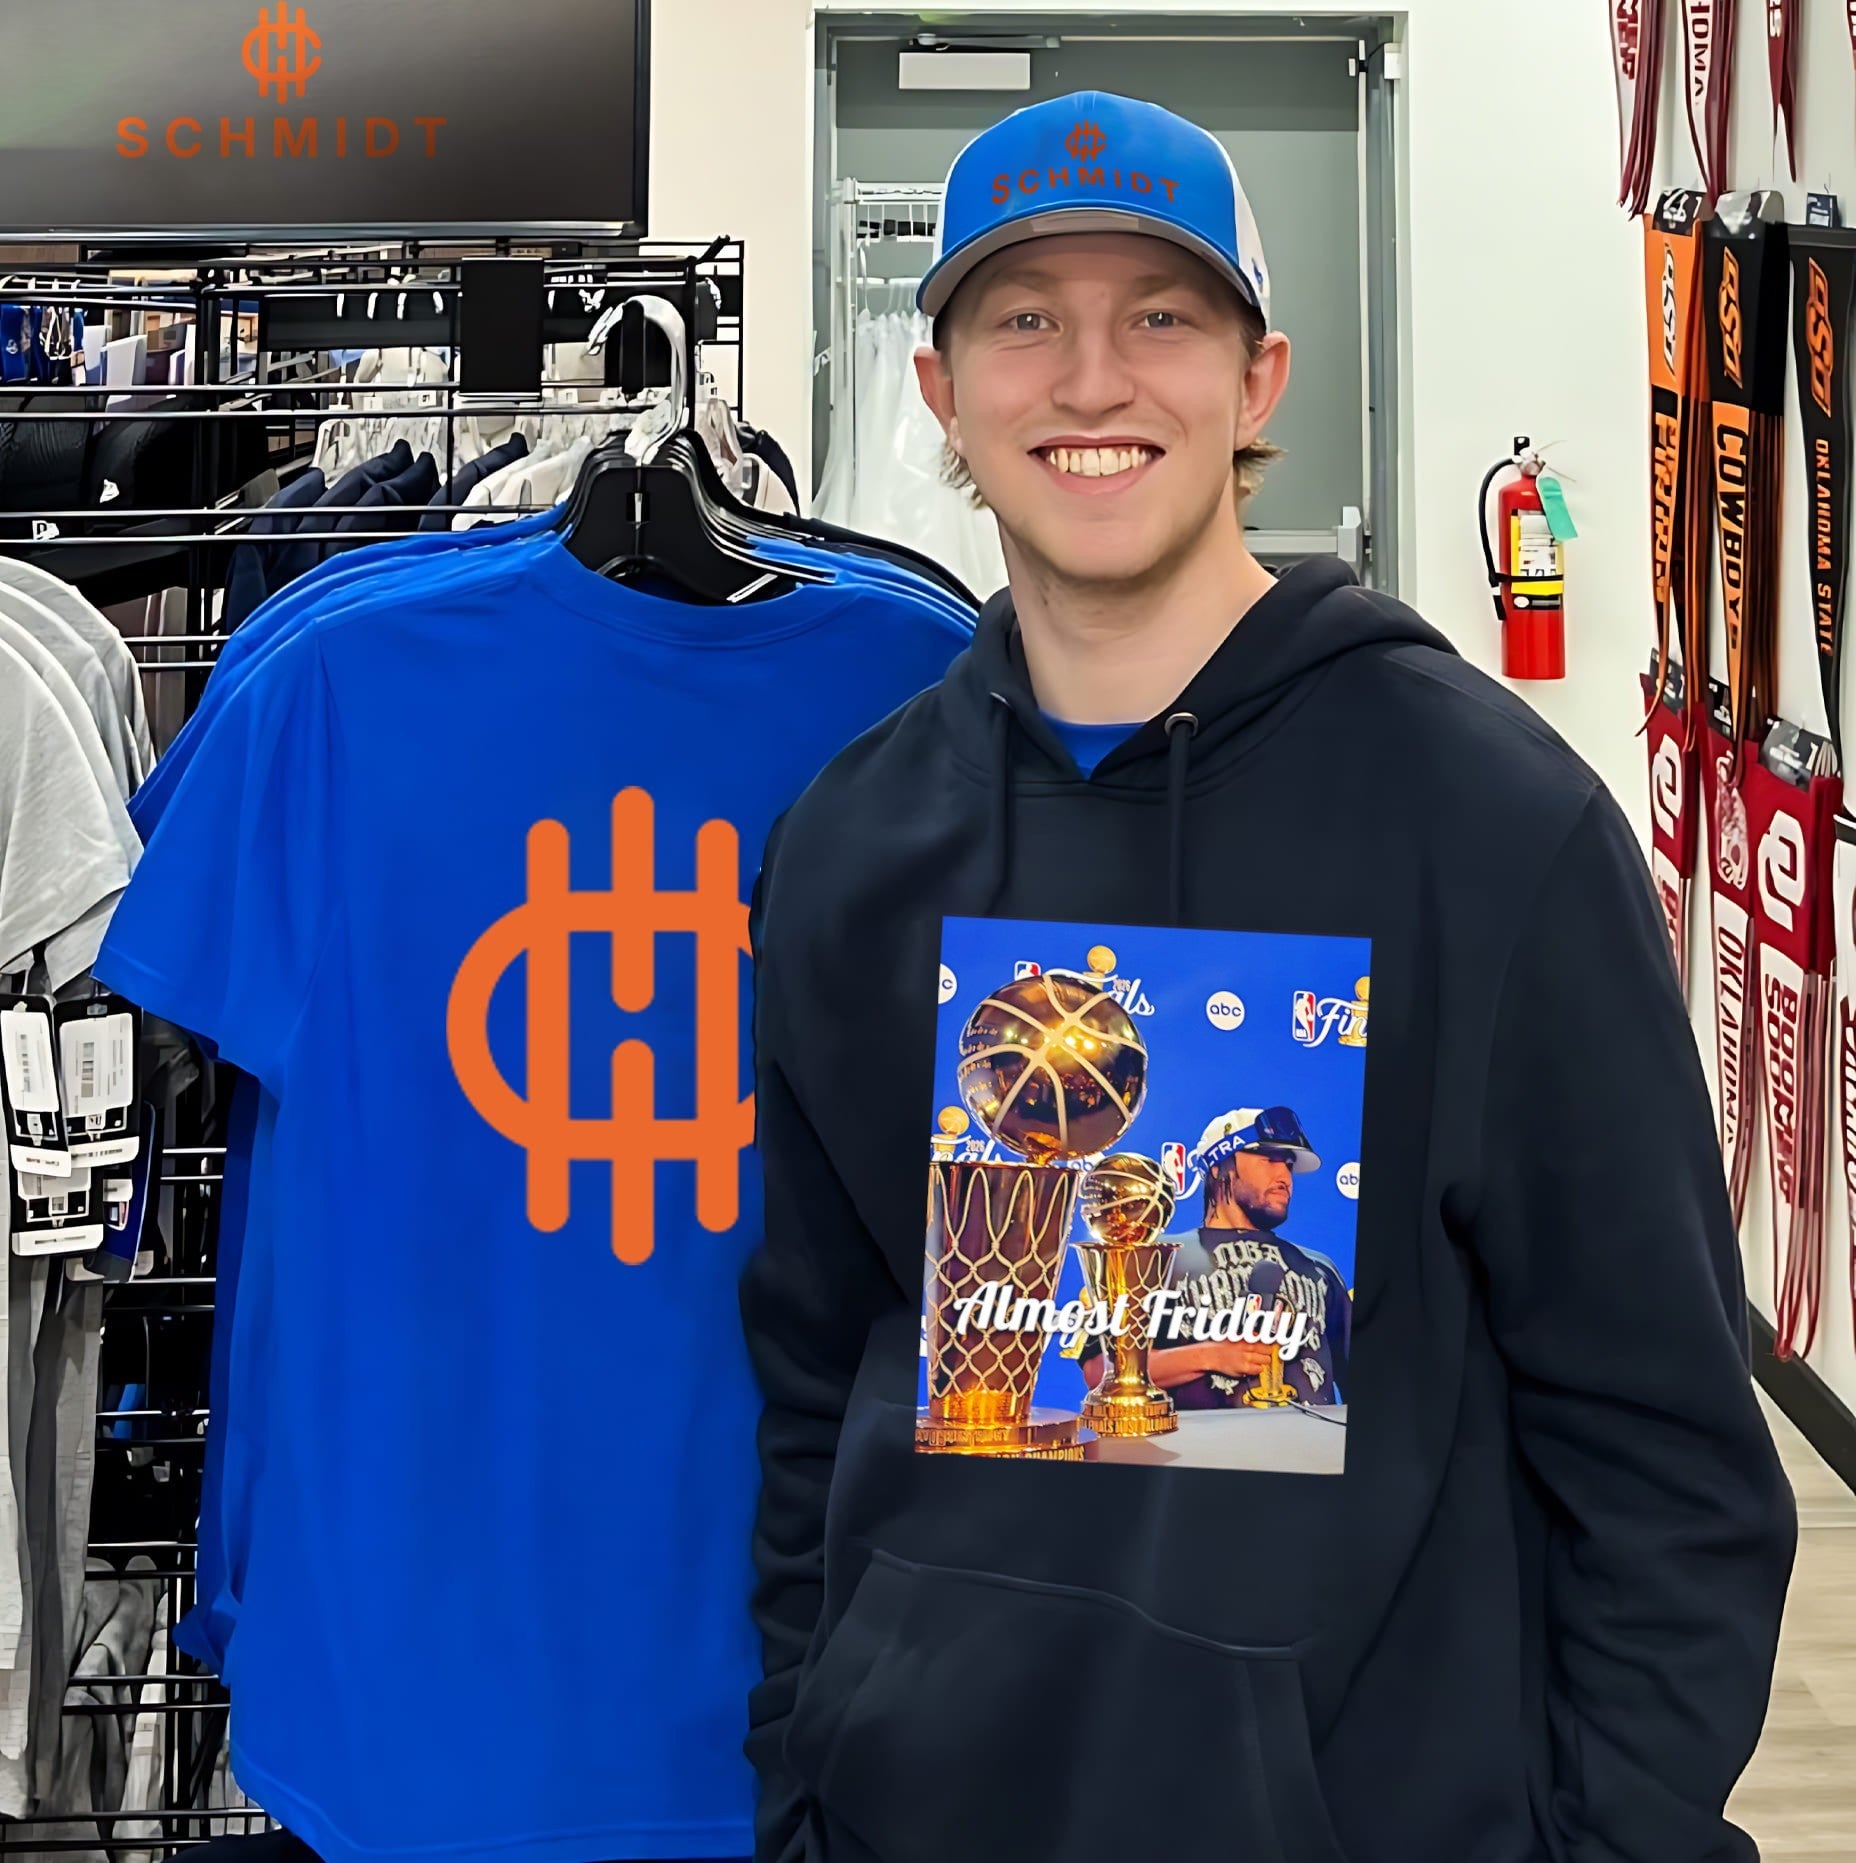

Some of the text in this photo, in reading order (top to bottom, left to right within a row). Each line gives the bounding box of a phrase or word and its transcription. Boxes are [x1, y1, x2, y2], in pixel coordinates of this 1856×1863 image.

[115, 117, 447, 158] SCHMIDT
[991, 167, 1180, 204] SCHMIDT
[1815, 438, 1832, 570] OKLAHOMA
[1209, 1002, 1242, 1017] abc
[1717, 925, 1746, 1144] OKLAHOMA
[1201, 1136, 1246, 1161] LTRA
[953, 1281, 1131, 1337] Almost
[1139, 1288, 1312, 1361] Friday
